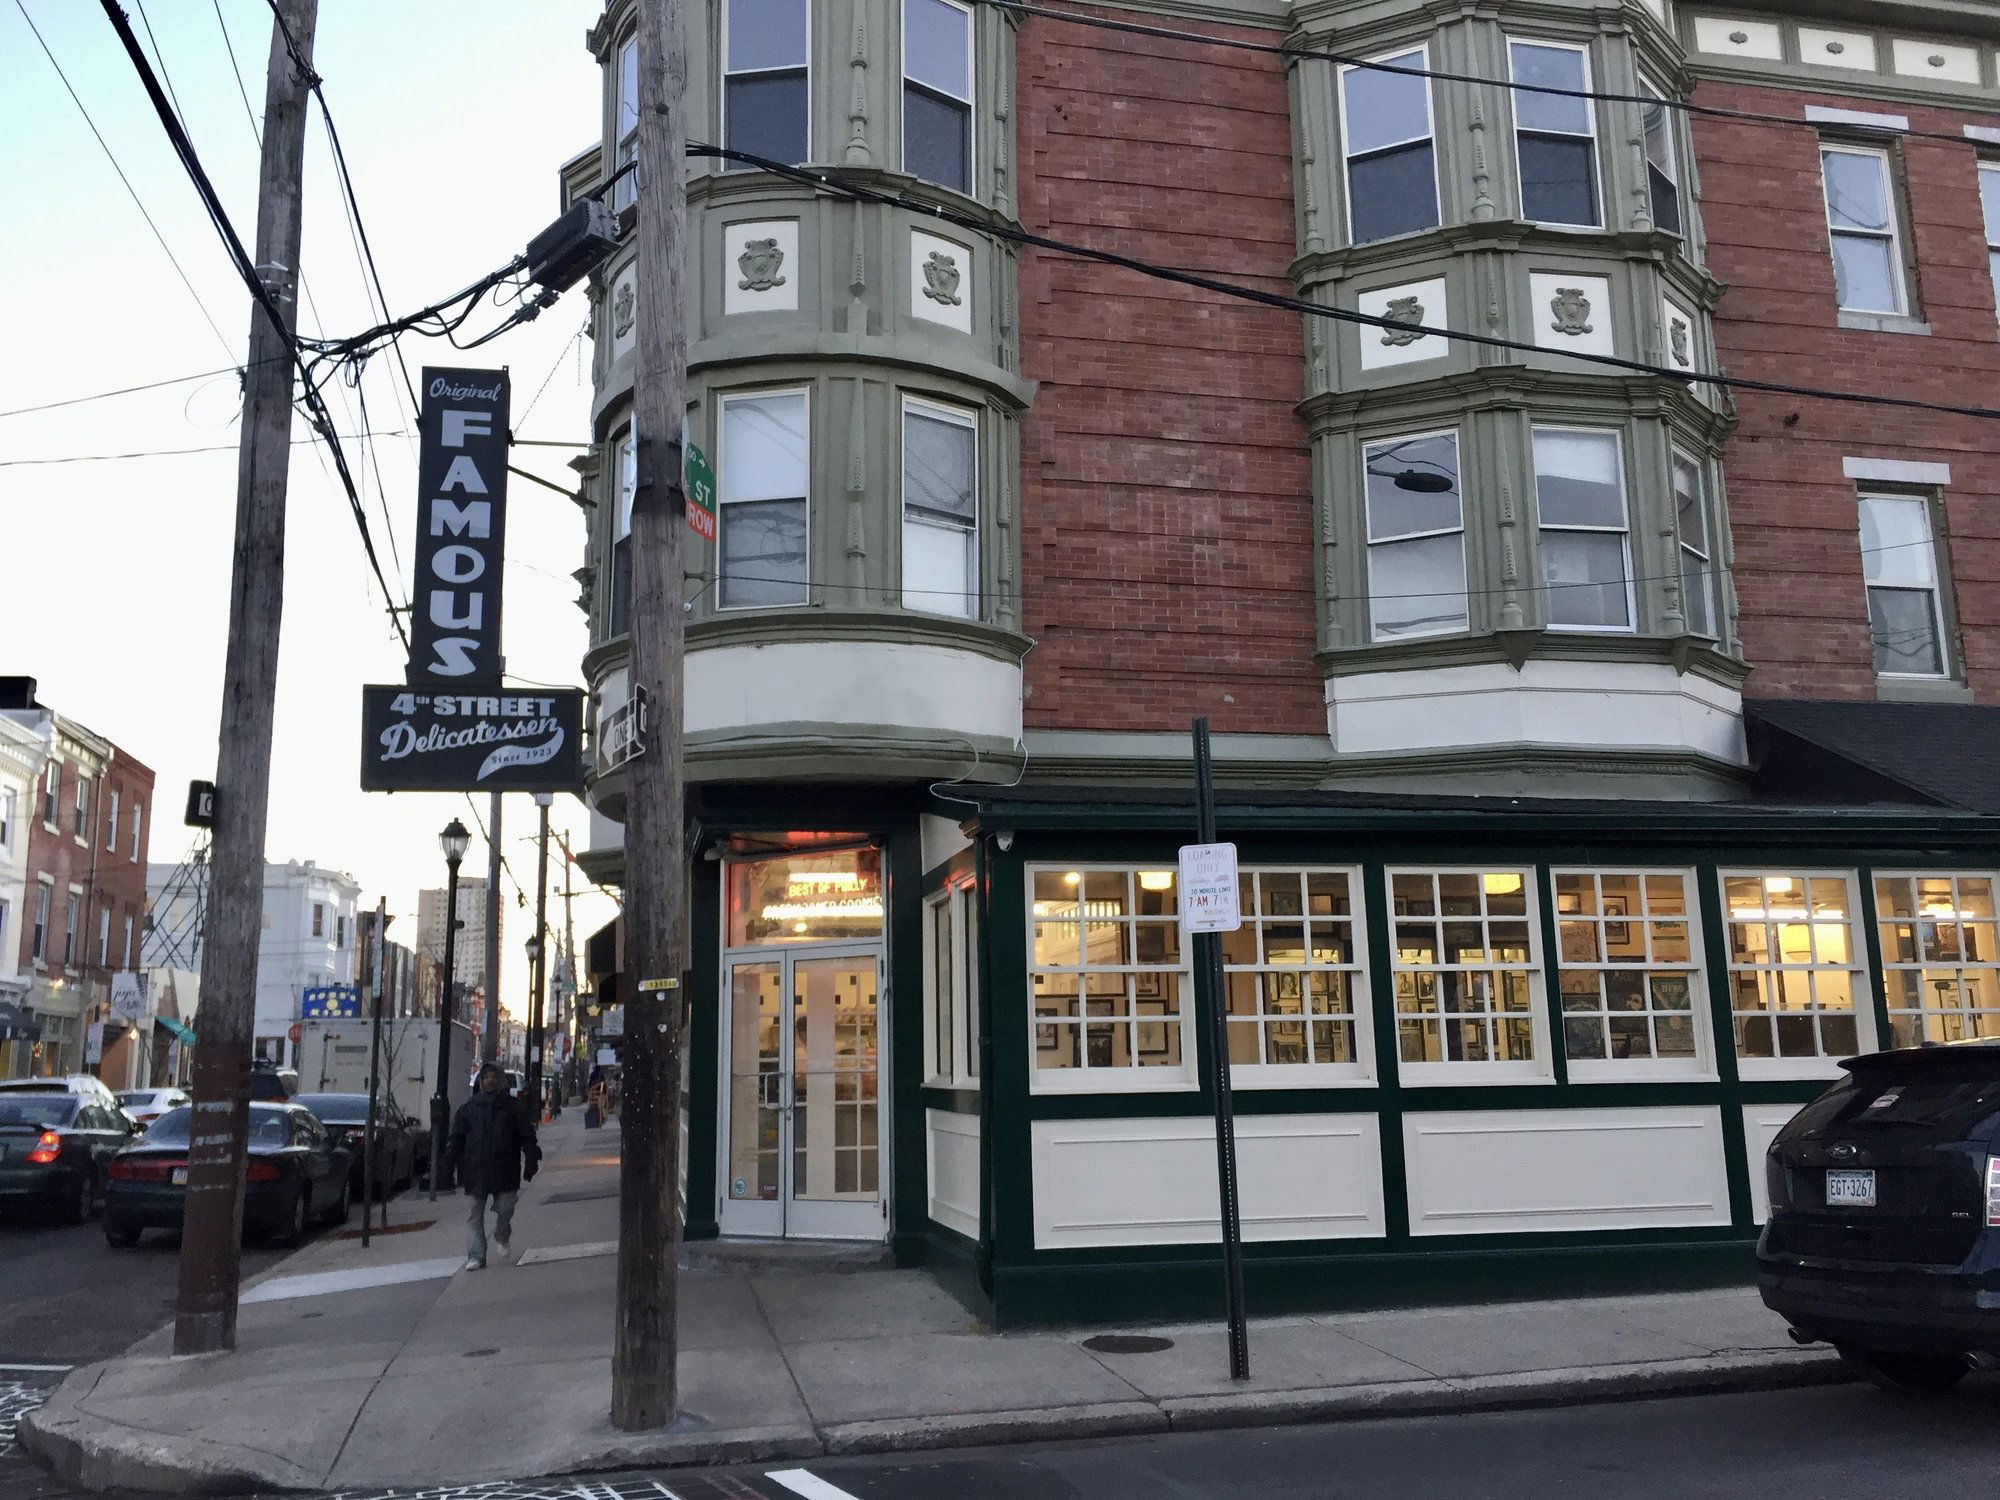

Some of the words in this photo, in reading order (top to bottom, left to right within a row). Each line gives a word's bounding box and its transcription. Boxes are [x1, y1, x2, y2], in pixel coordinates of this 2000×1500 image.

[429, 377, 502, 402] Original
[695, 480, 711, 507] ST
[687, 502, 714, 538] ROW
[427, 409, 492, 677] FAMOUS
[433, 695, 556, 717] STREET
[379, 717, 558, 762] Delicatessen
[491, 754, 520, 765] Since
[525, 748, 552, 759] 1923
[1187, 848, 1228, 863] LOADING
[1196, 862, 1220, 875] ONLY
[788, 882, 814, 898] BEST
[818, 880, 831, 894] OF
[834, 878, 868, 893] PHILLY
[1196, 896, 1209, 908] AM
